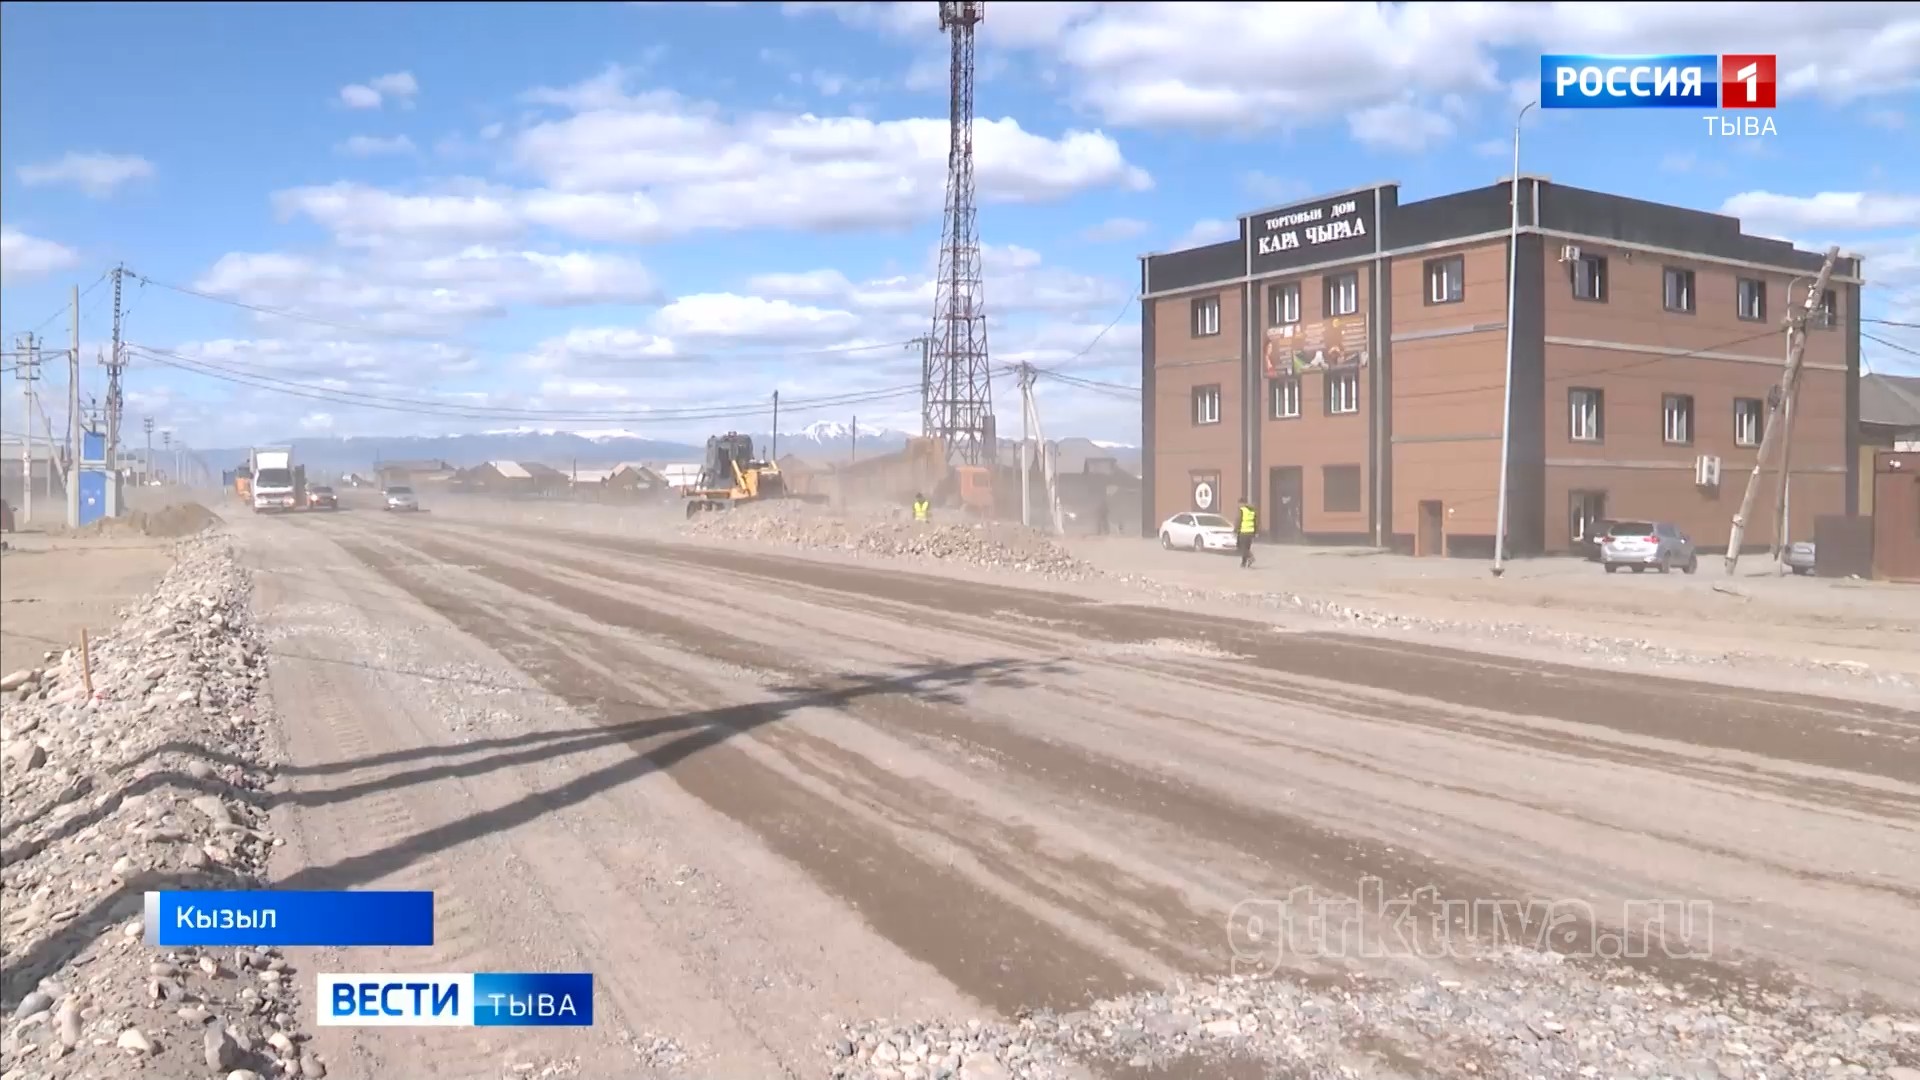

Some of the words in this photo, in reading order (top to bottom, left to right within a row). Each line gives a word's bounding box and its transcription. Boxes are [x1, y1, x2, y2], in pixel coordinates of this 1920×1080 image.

[1331, 200, 1356, 218] ДОМ
[1258, 230, 1299, 255] КАРА
[1305, 217, 1366, 245] ЧЫРАА
